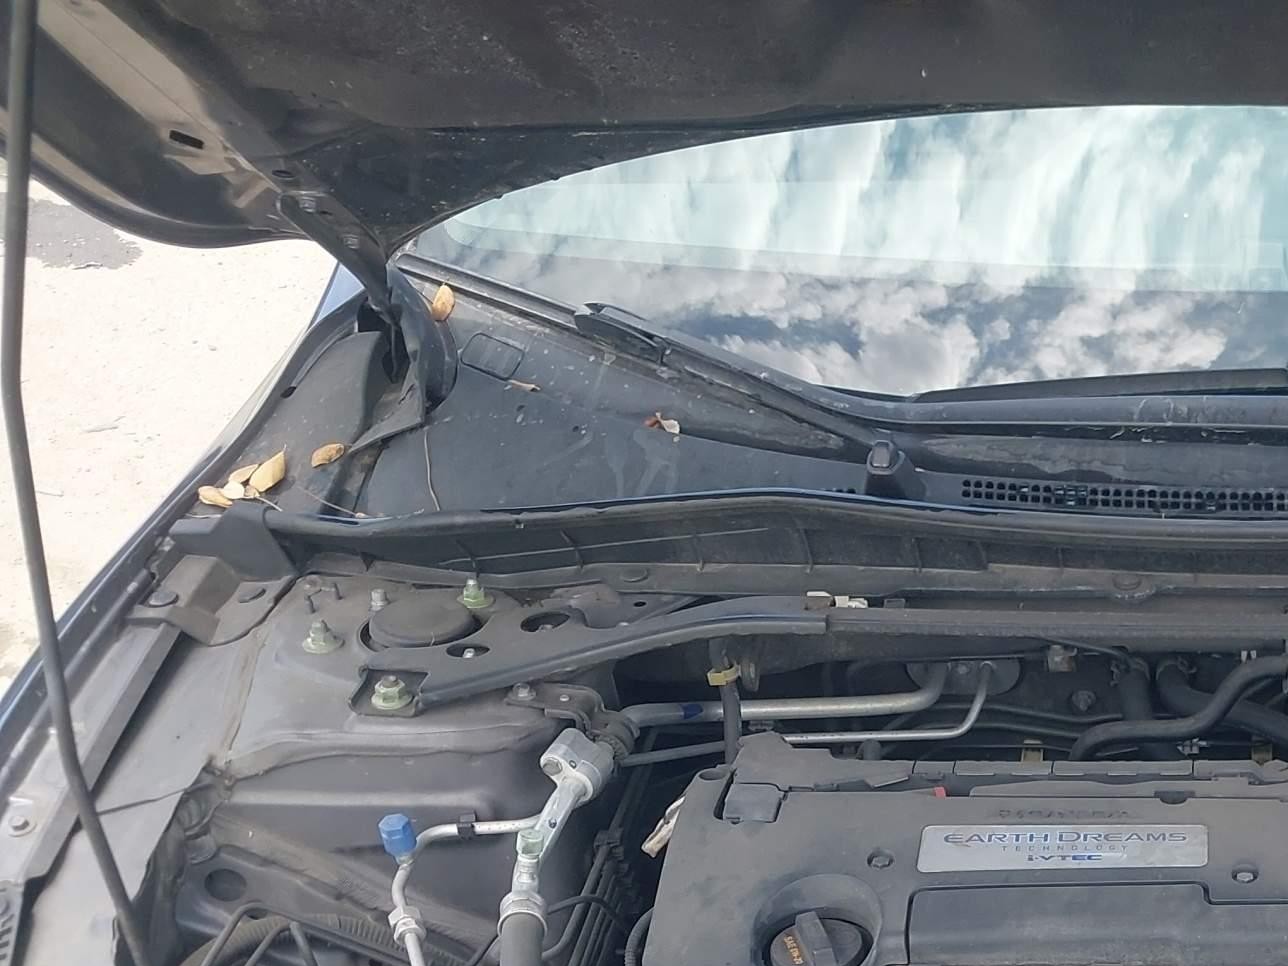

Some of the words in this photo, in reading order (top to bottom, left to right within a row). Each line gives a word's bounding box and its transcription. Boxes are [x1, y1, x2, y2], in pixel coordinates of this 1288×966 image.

[943, 831, 1049, 844] EARTH
[1057, 830, 1187, 843] DREAMS
[1001, 844, 1128, 852] TECHNOLOGY
